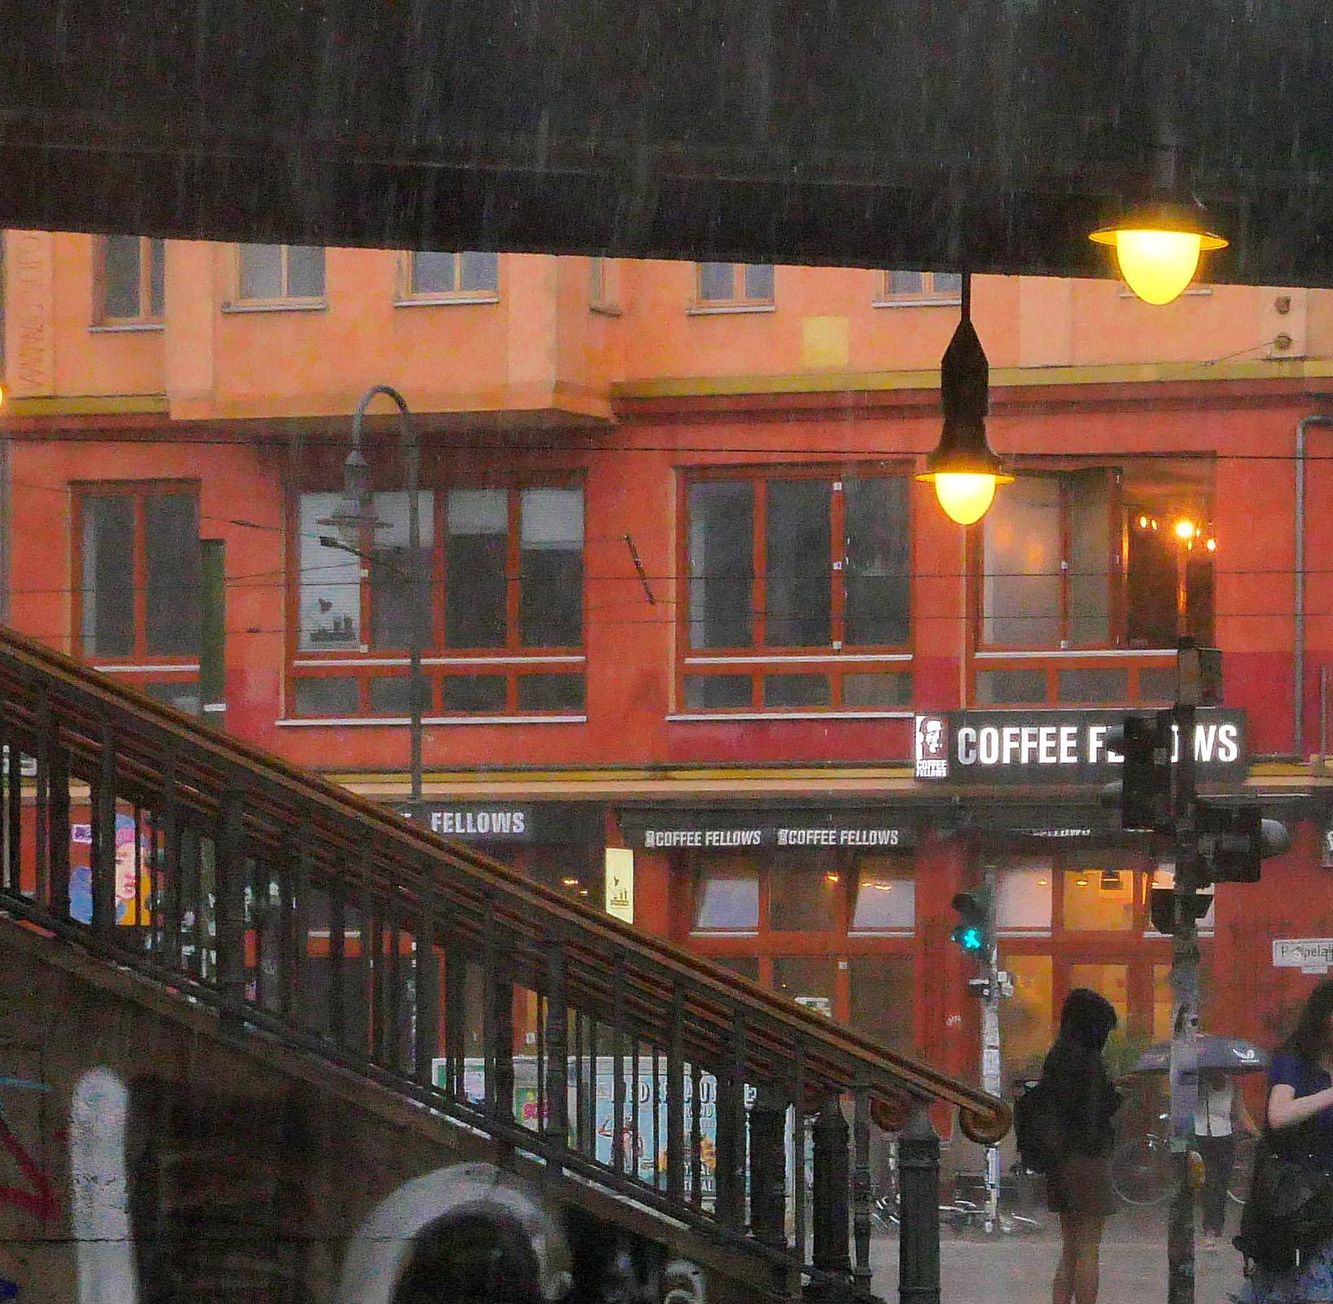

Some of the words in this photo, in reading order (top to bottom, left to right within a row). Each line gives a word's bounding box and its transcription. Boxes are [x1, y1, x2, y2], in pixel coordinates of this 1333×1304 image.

[957, 726, 1079, 765] COFFEE
[1088, 724, 1239, 764] FEWS
[916, 760, 948, 770] COFFEE
[916, 769, 947, 777] FELLOWS
[430, 812, 526, 834] FELLOWS
[655, 832, 702, 847] COFFEE
[705, 830, 761, 847] FELLOWS
[789, 830, 836, 846] COFFEE
[839, 829, 899, 846] FELLOWS
